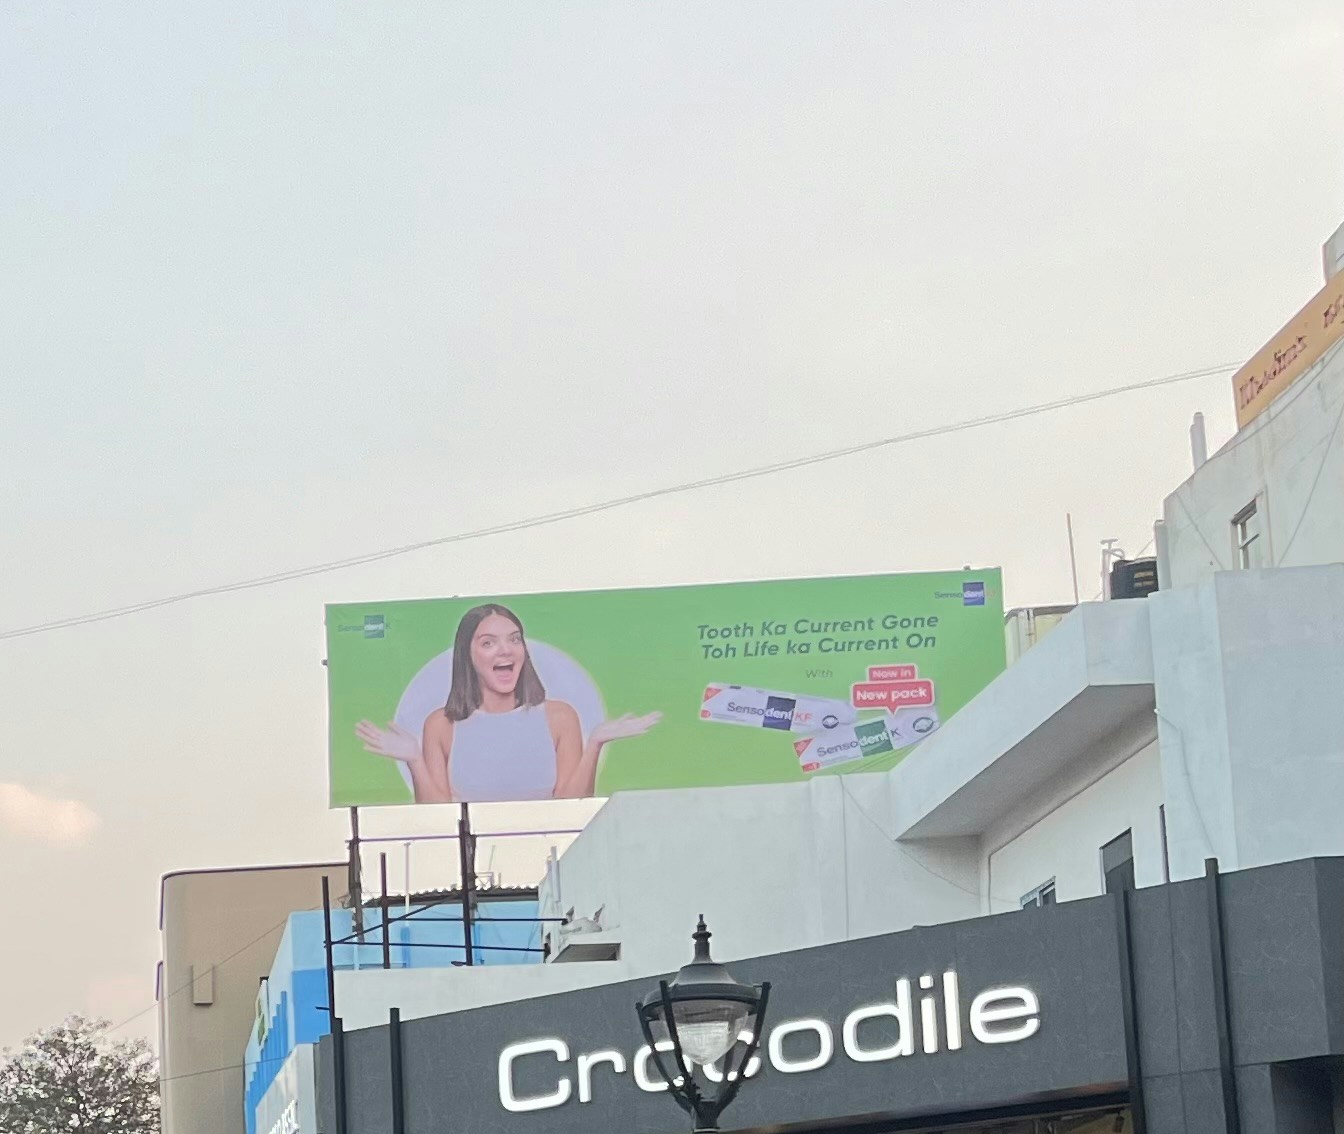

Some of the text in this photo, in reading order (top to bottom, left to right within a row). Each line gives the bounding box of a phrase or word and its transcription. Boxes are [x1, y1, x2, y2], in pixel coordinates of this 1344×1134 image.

[697, 614, 939, 640] Tooth Ka Current Gone
[701, 633, 937, 659] Toh Life ka Current On
[804, 669, 833, 679] With
[901, 668, 913, 677] in
[856, 687, 929, 702] New pack
[727, 702, 793, 721] Sensodent
[816, 730, 890, 757] Sensodent
